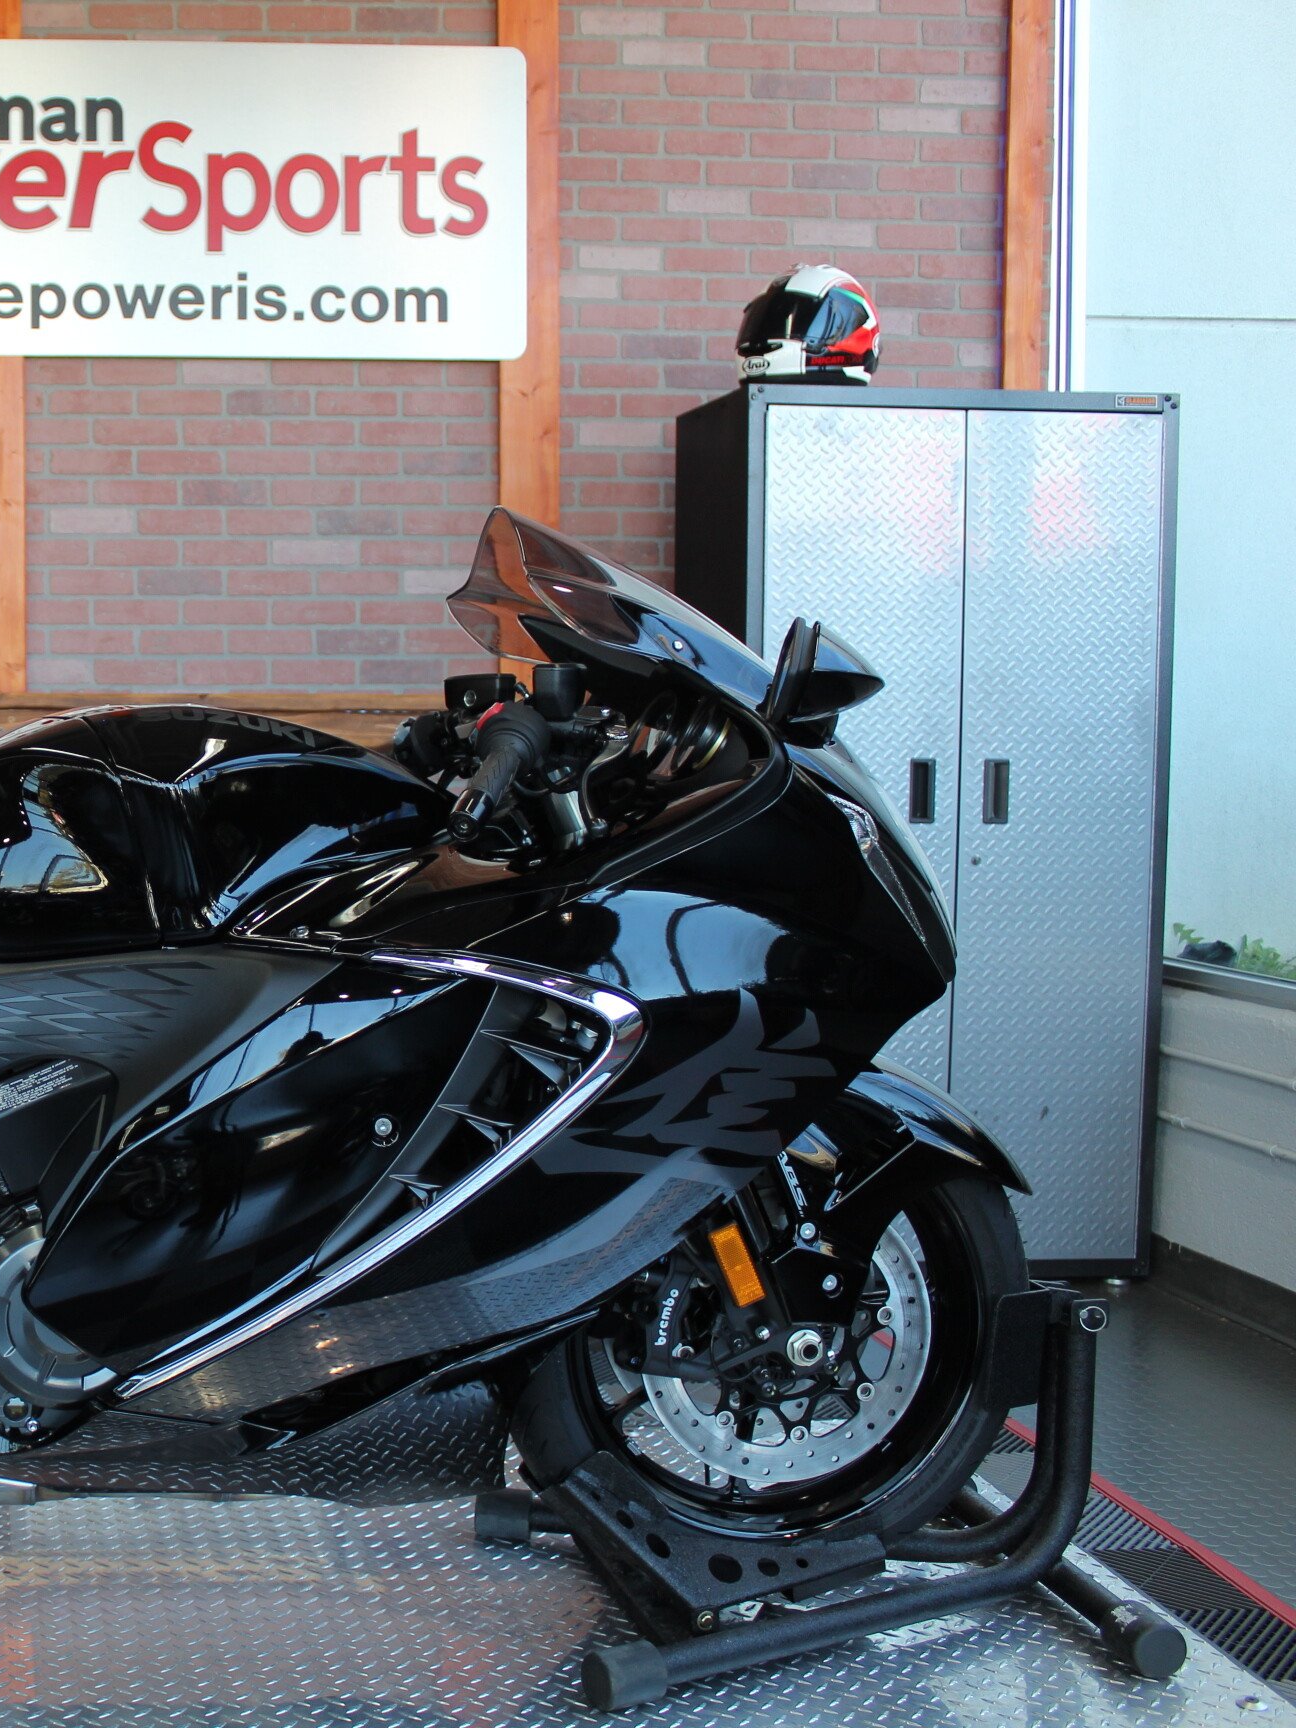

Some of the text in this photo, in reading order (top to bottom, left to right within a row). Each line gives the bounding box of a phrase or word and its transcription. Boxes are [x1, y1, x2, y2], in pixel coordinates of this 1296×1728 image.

[746, 359, 766, 369] Arai
[811, 355, 845, 365] DUCATI
[136, 708, 316, 748] SUZUKI
[654, 1288, 679, 1346] brembo
